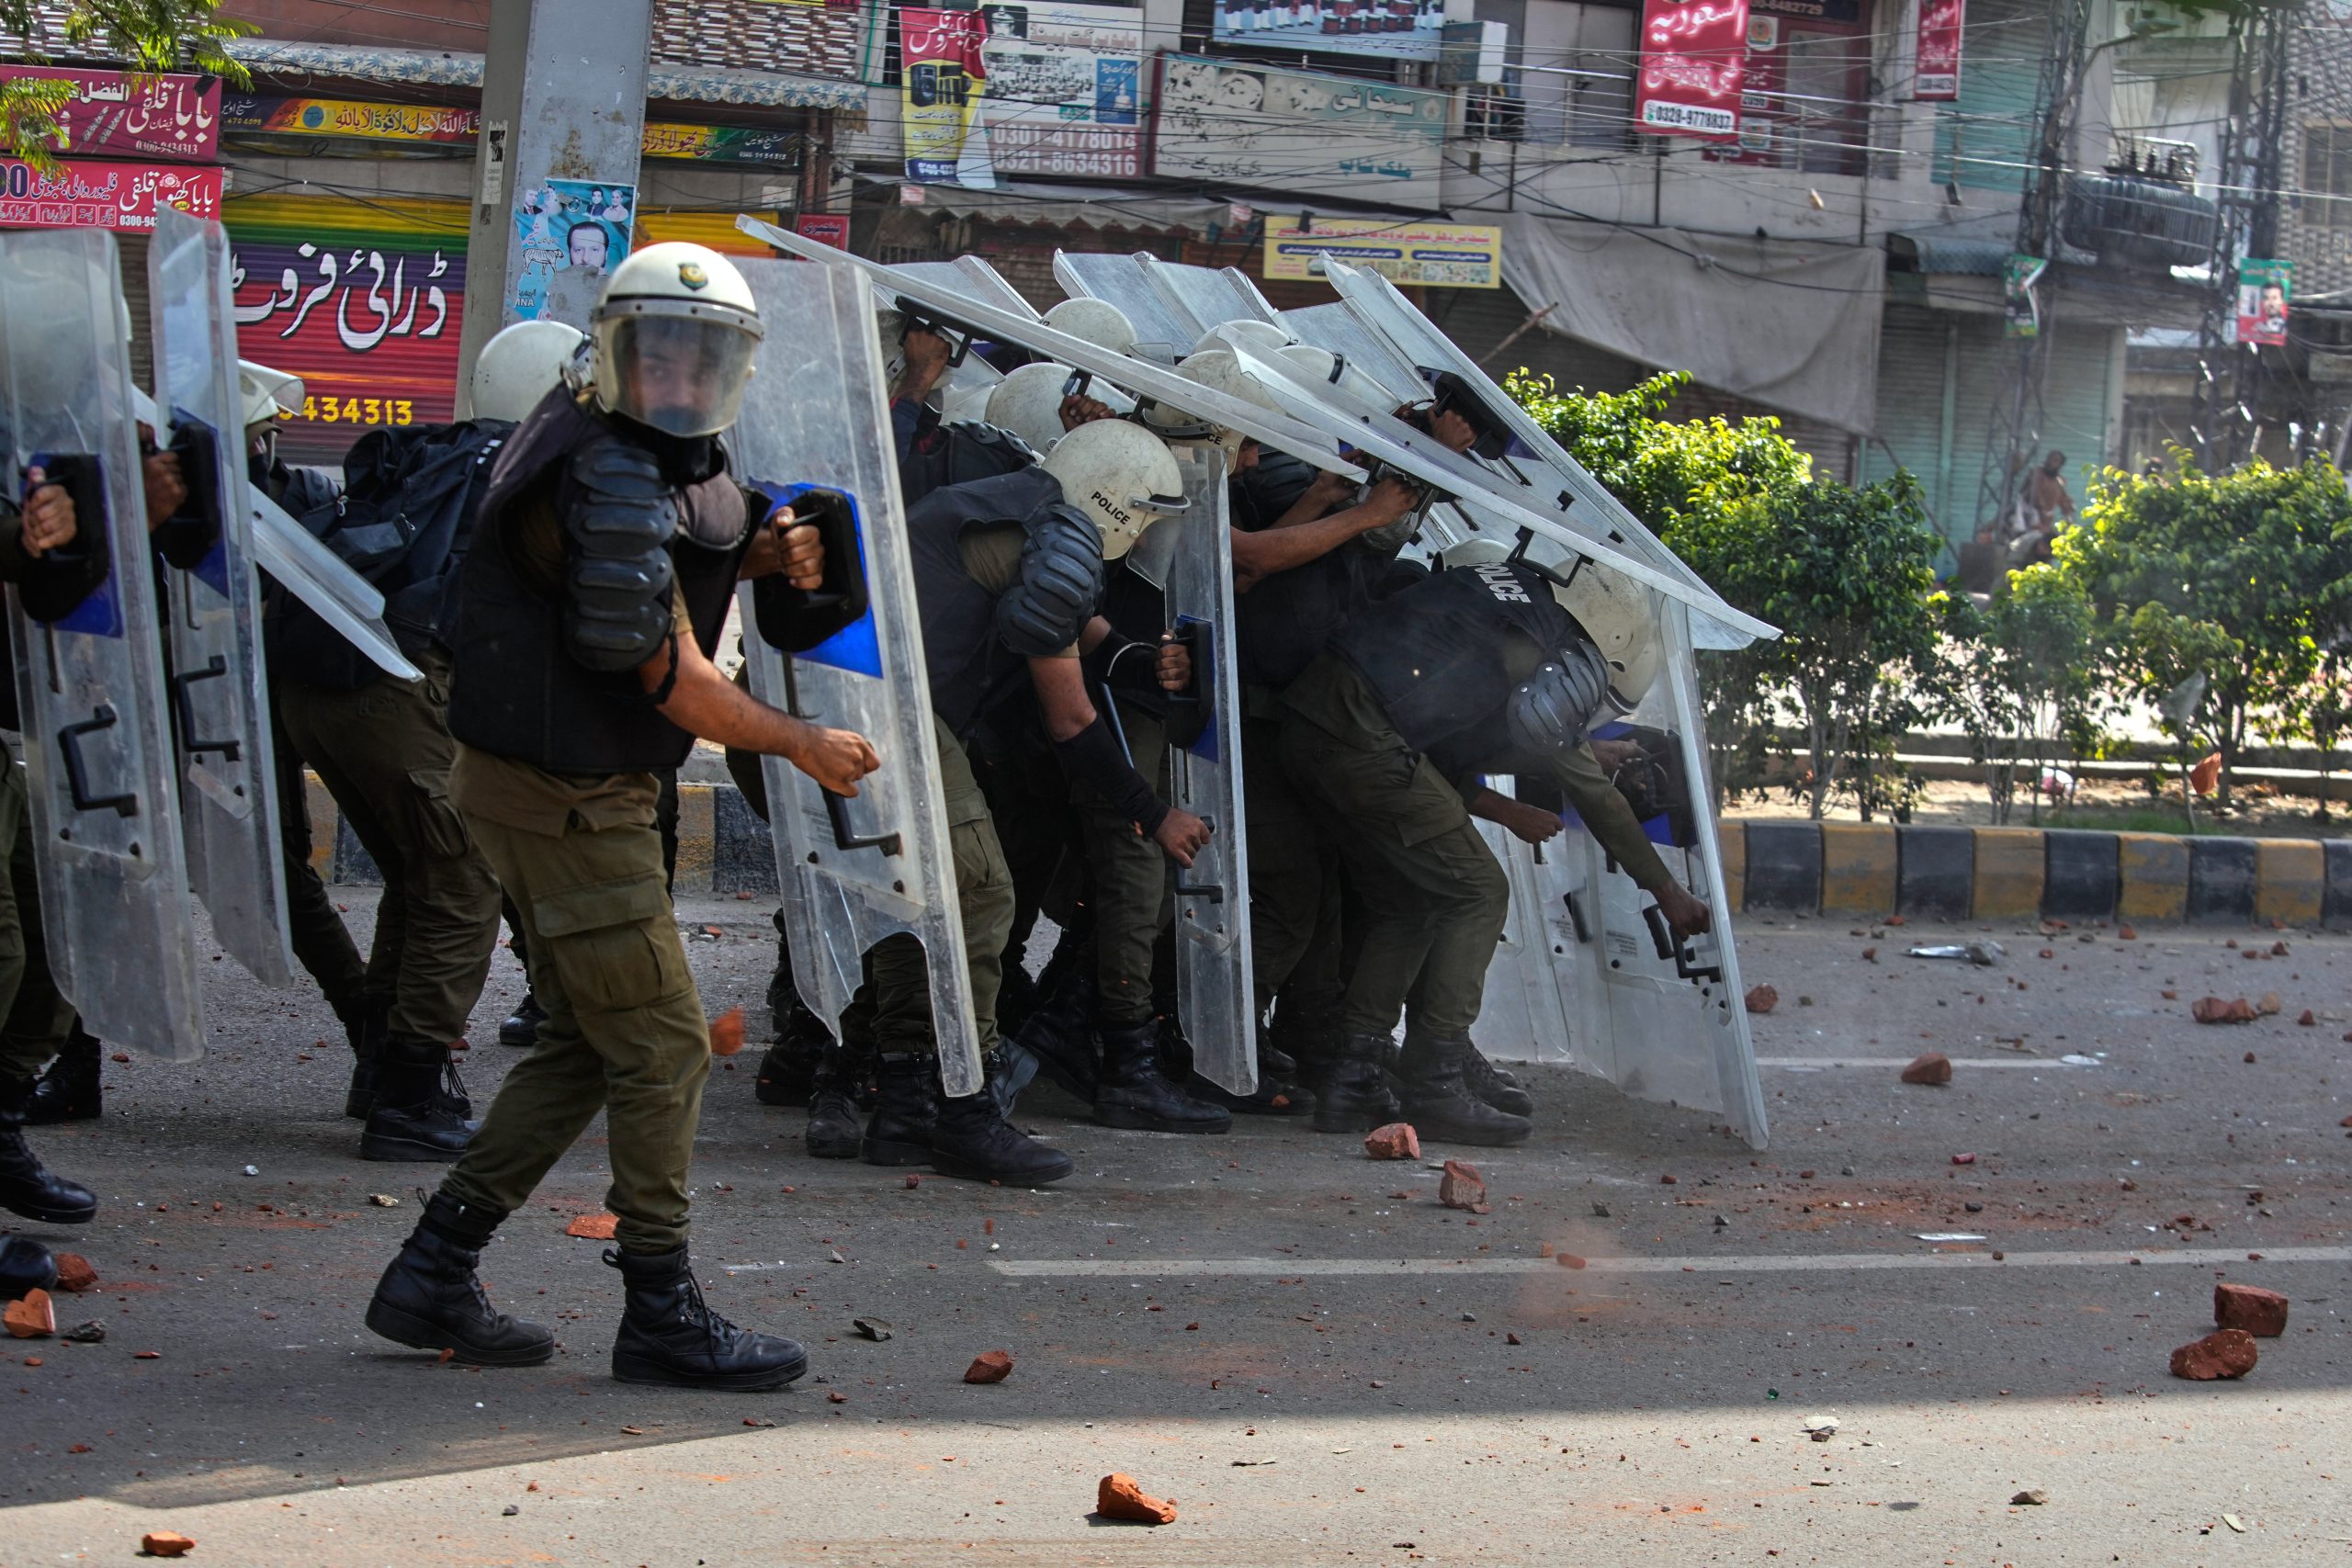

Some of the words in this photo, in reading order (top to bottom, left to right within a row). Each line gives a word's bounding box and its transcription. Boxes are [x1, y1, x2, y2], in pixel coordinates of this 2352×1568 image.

[126, 80, 175, 134] قلفی
[175, 82, 214, 143] بابا
[135, 139, 198, 155] 0300-9434313
[993, 123, 1137, 151] 0301-4178014
[993, 147, 1137, 176] 0321-8634316
[119, 214, 158, 228] 0300-943
[232, 242, 339, 340] فروٹ
[337, 246, 449, 353] ڈرائی
[1091, 491, 1131, 525] POLICE
